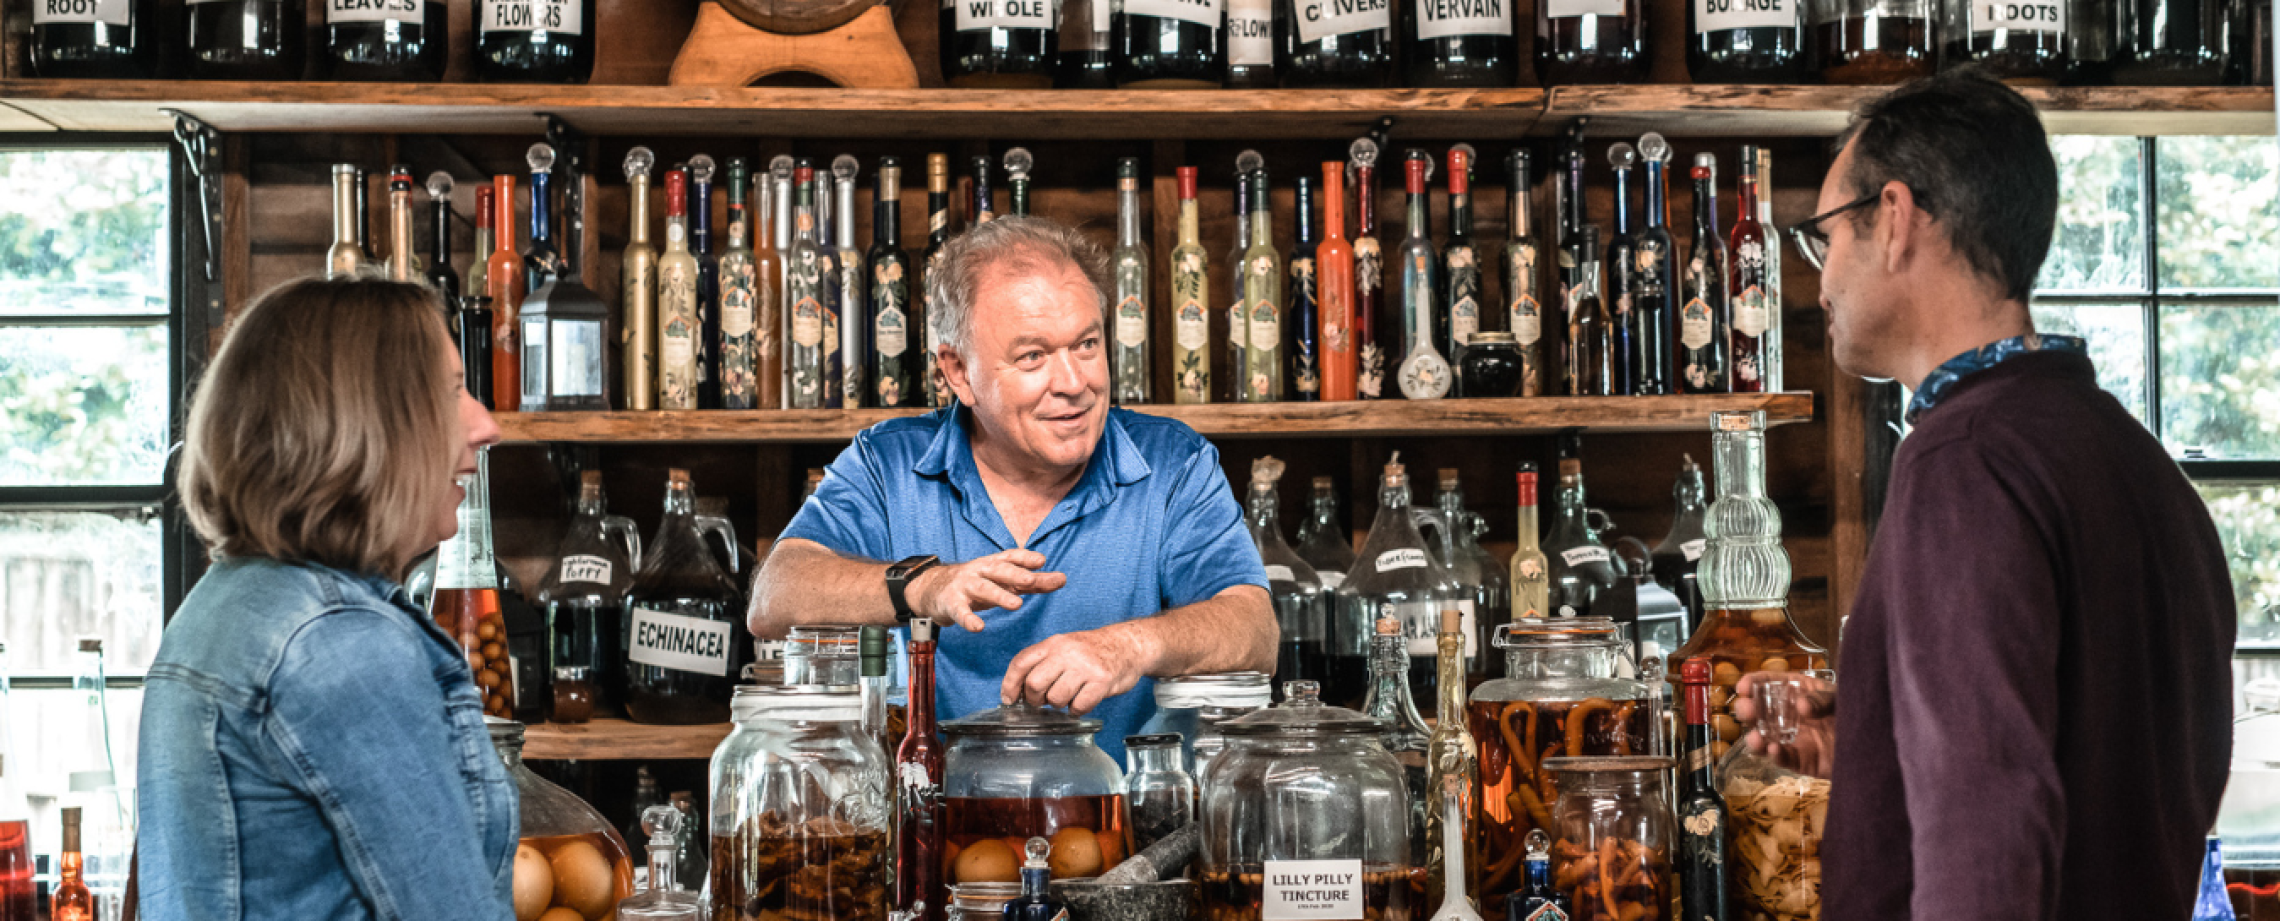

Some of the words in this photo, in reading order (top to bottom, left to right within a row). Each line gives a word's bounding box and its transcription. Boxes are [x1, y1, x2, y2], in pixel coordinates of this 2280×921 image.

[47, 0, 97, 15] ROOT
[1424, 0, 1502, 22] VERVAIN
[1706, 0, 1782, 14] BOAGE
[496, 4, 562, 27] FLOWRS
[637, 620, 724, 660] ECHINACEA
[1273, 874, 1310, 886] LILLY
[1314, 873, 1353, 885] PILLY
[1280, 889, 1349, 902] TINCTURE
